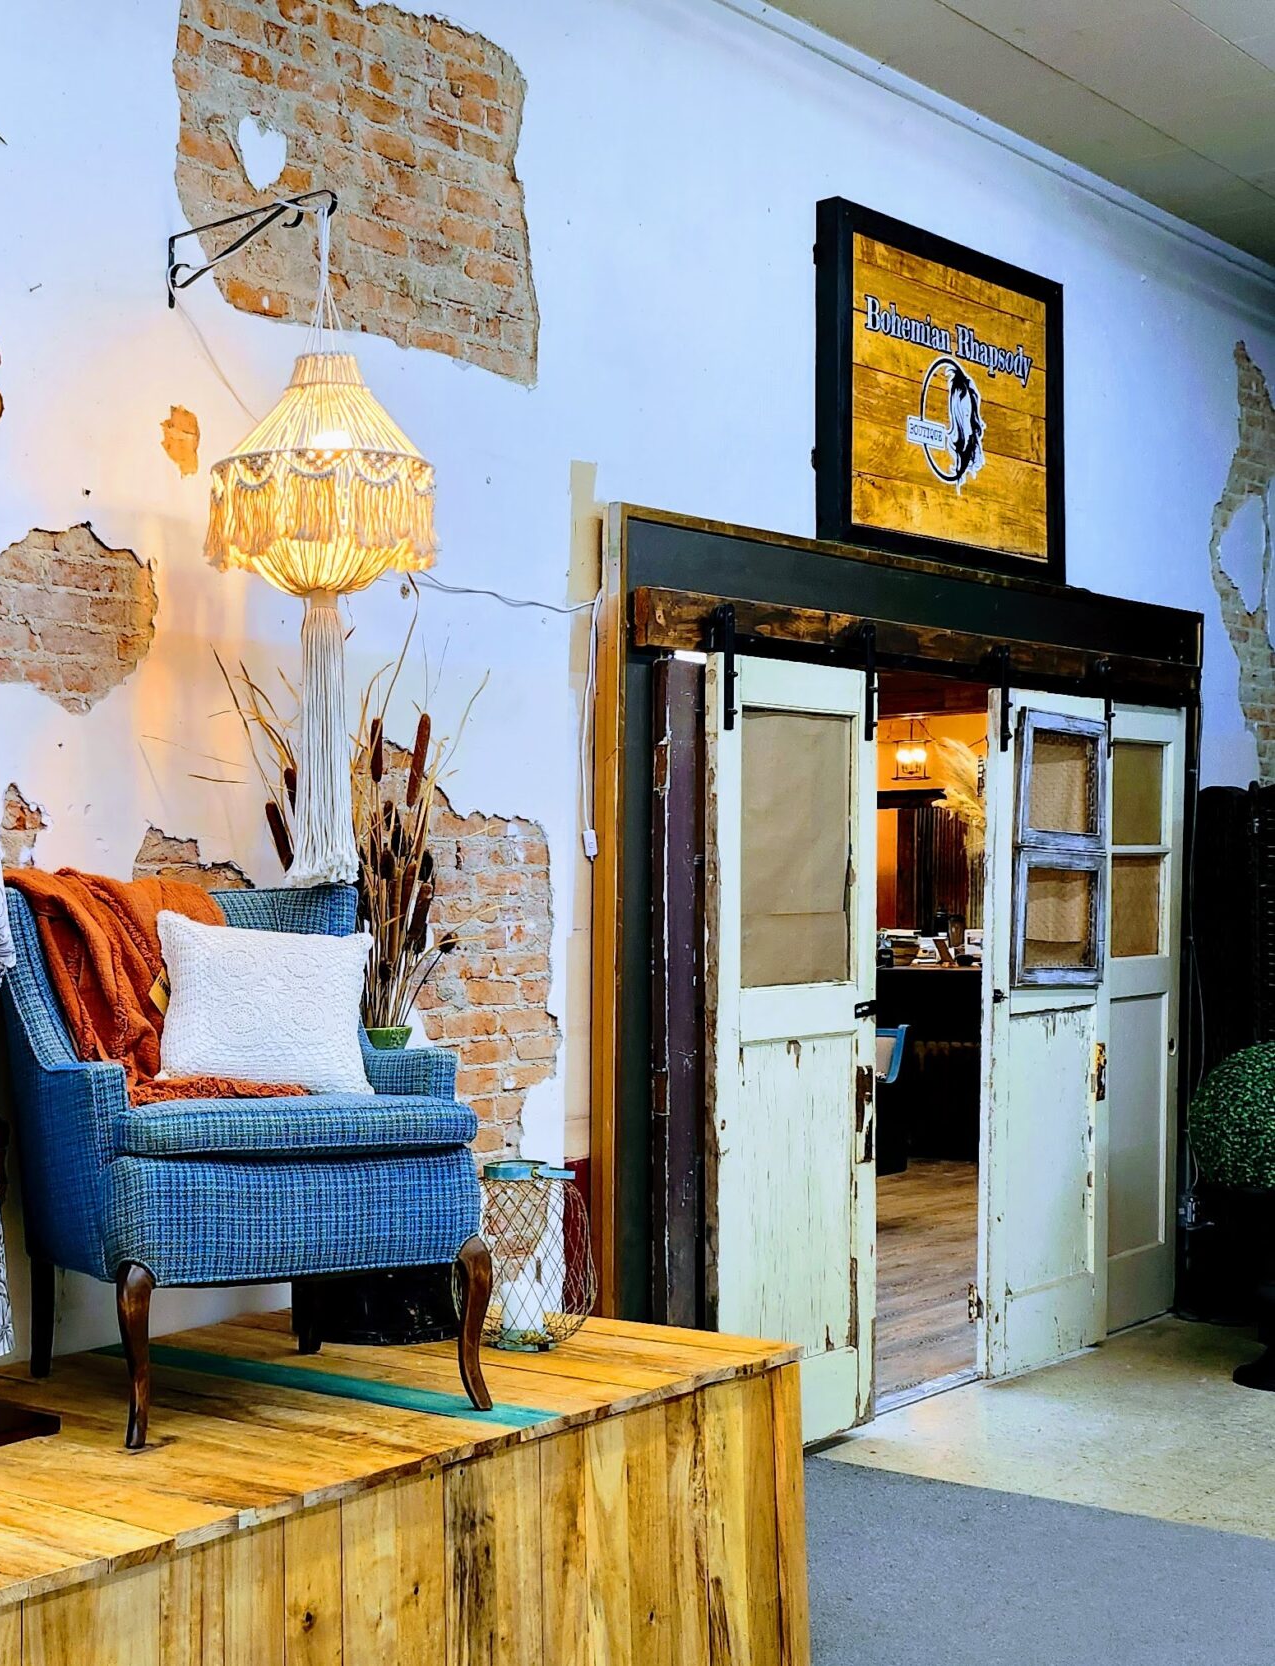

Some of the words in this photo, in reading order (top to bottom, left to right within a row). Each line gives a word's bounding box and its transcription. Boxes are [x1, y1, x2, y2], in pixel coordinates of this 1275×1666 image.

[865, 294, 952, 355] Bohemian
[955, 323, 1033, 388] Rhapsody
[909, 422, 943, 442] BOUTIQUE
